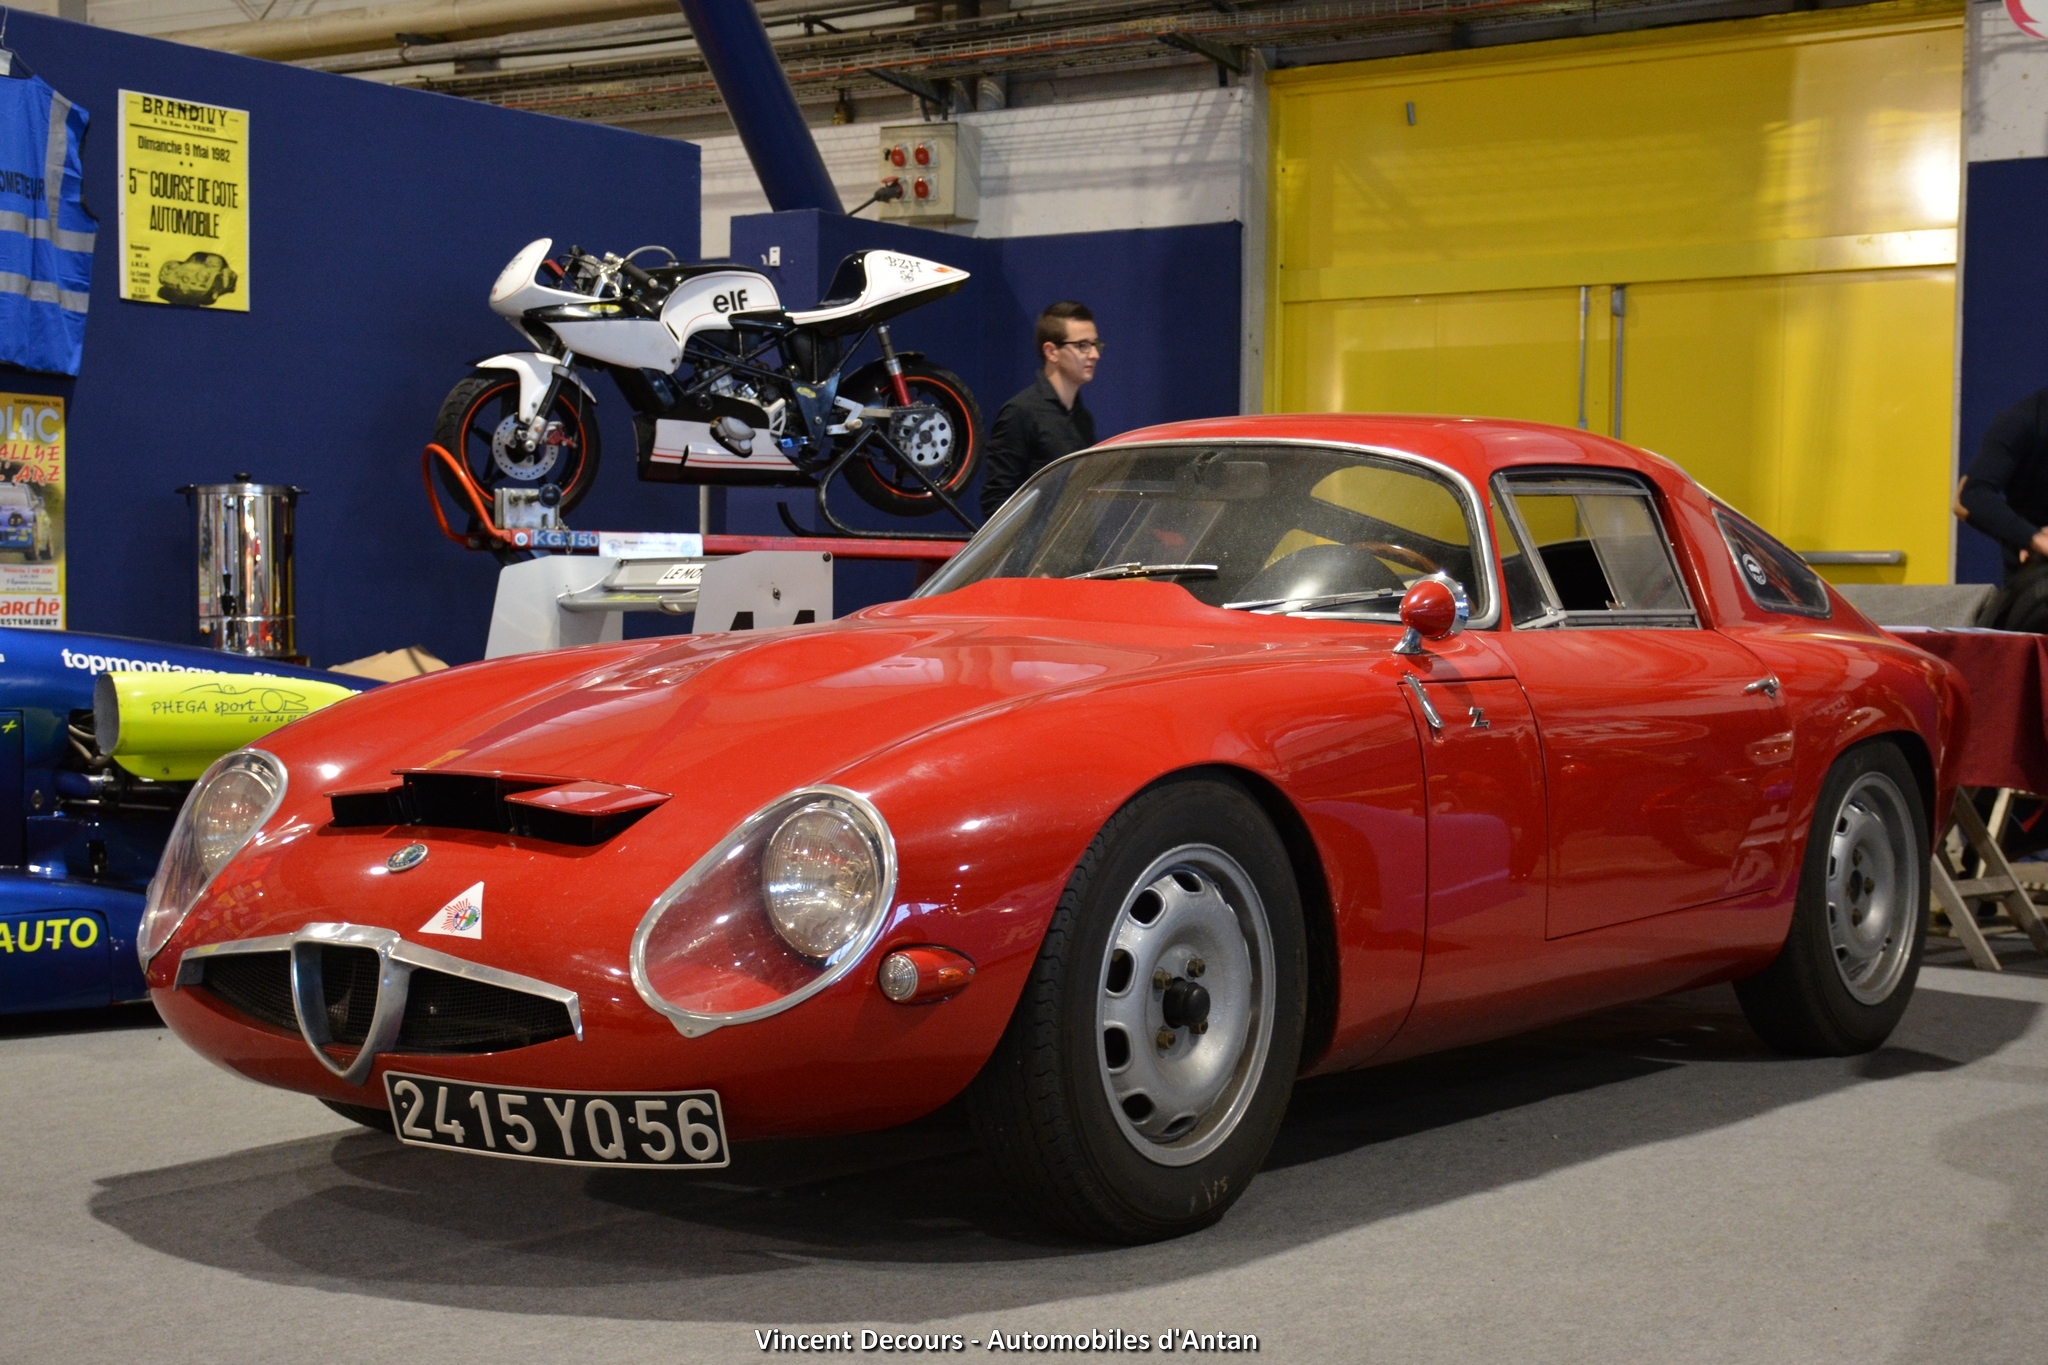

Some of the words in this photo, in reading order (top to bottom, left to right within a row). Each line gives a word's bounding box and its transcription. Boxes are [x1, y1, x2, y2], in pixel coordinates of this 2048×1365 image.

[142, 96, 227, 127] BRANDIVY
[138, 135, 182, 155] Dimanche
[184, 142, 190, 156] 9
[193, 143, 209, 159] Mai
[212, 146, 231, 163] 1982
[150, 171, 194, 202] COURSE
[197, 177, 210, 204] DE
[212, 180, 238, 208] COTE
[150, 205, 219, 239] AUTOMOBILE
[712, 289, 748, 314] elf
[663, 568, 683, 580] LE
[152, 700, 208, 714] PHEGA
[214, 699, 256, 716] sport
[249, 715, 259, 723] 04
[262, 715, 271, 723] 74
[275, 715, 285, 723] 34
[394, 1079, 537, 1151] 2415
[543, 1097, 627, 1160] YQ
[634, 1099, 719, 1161] 56
